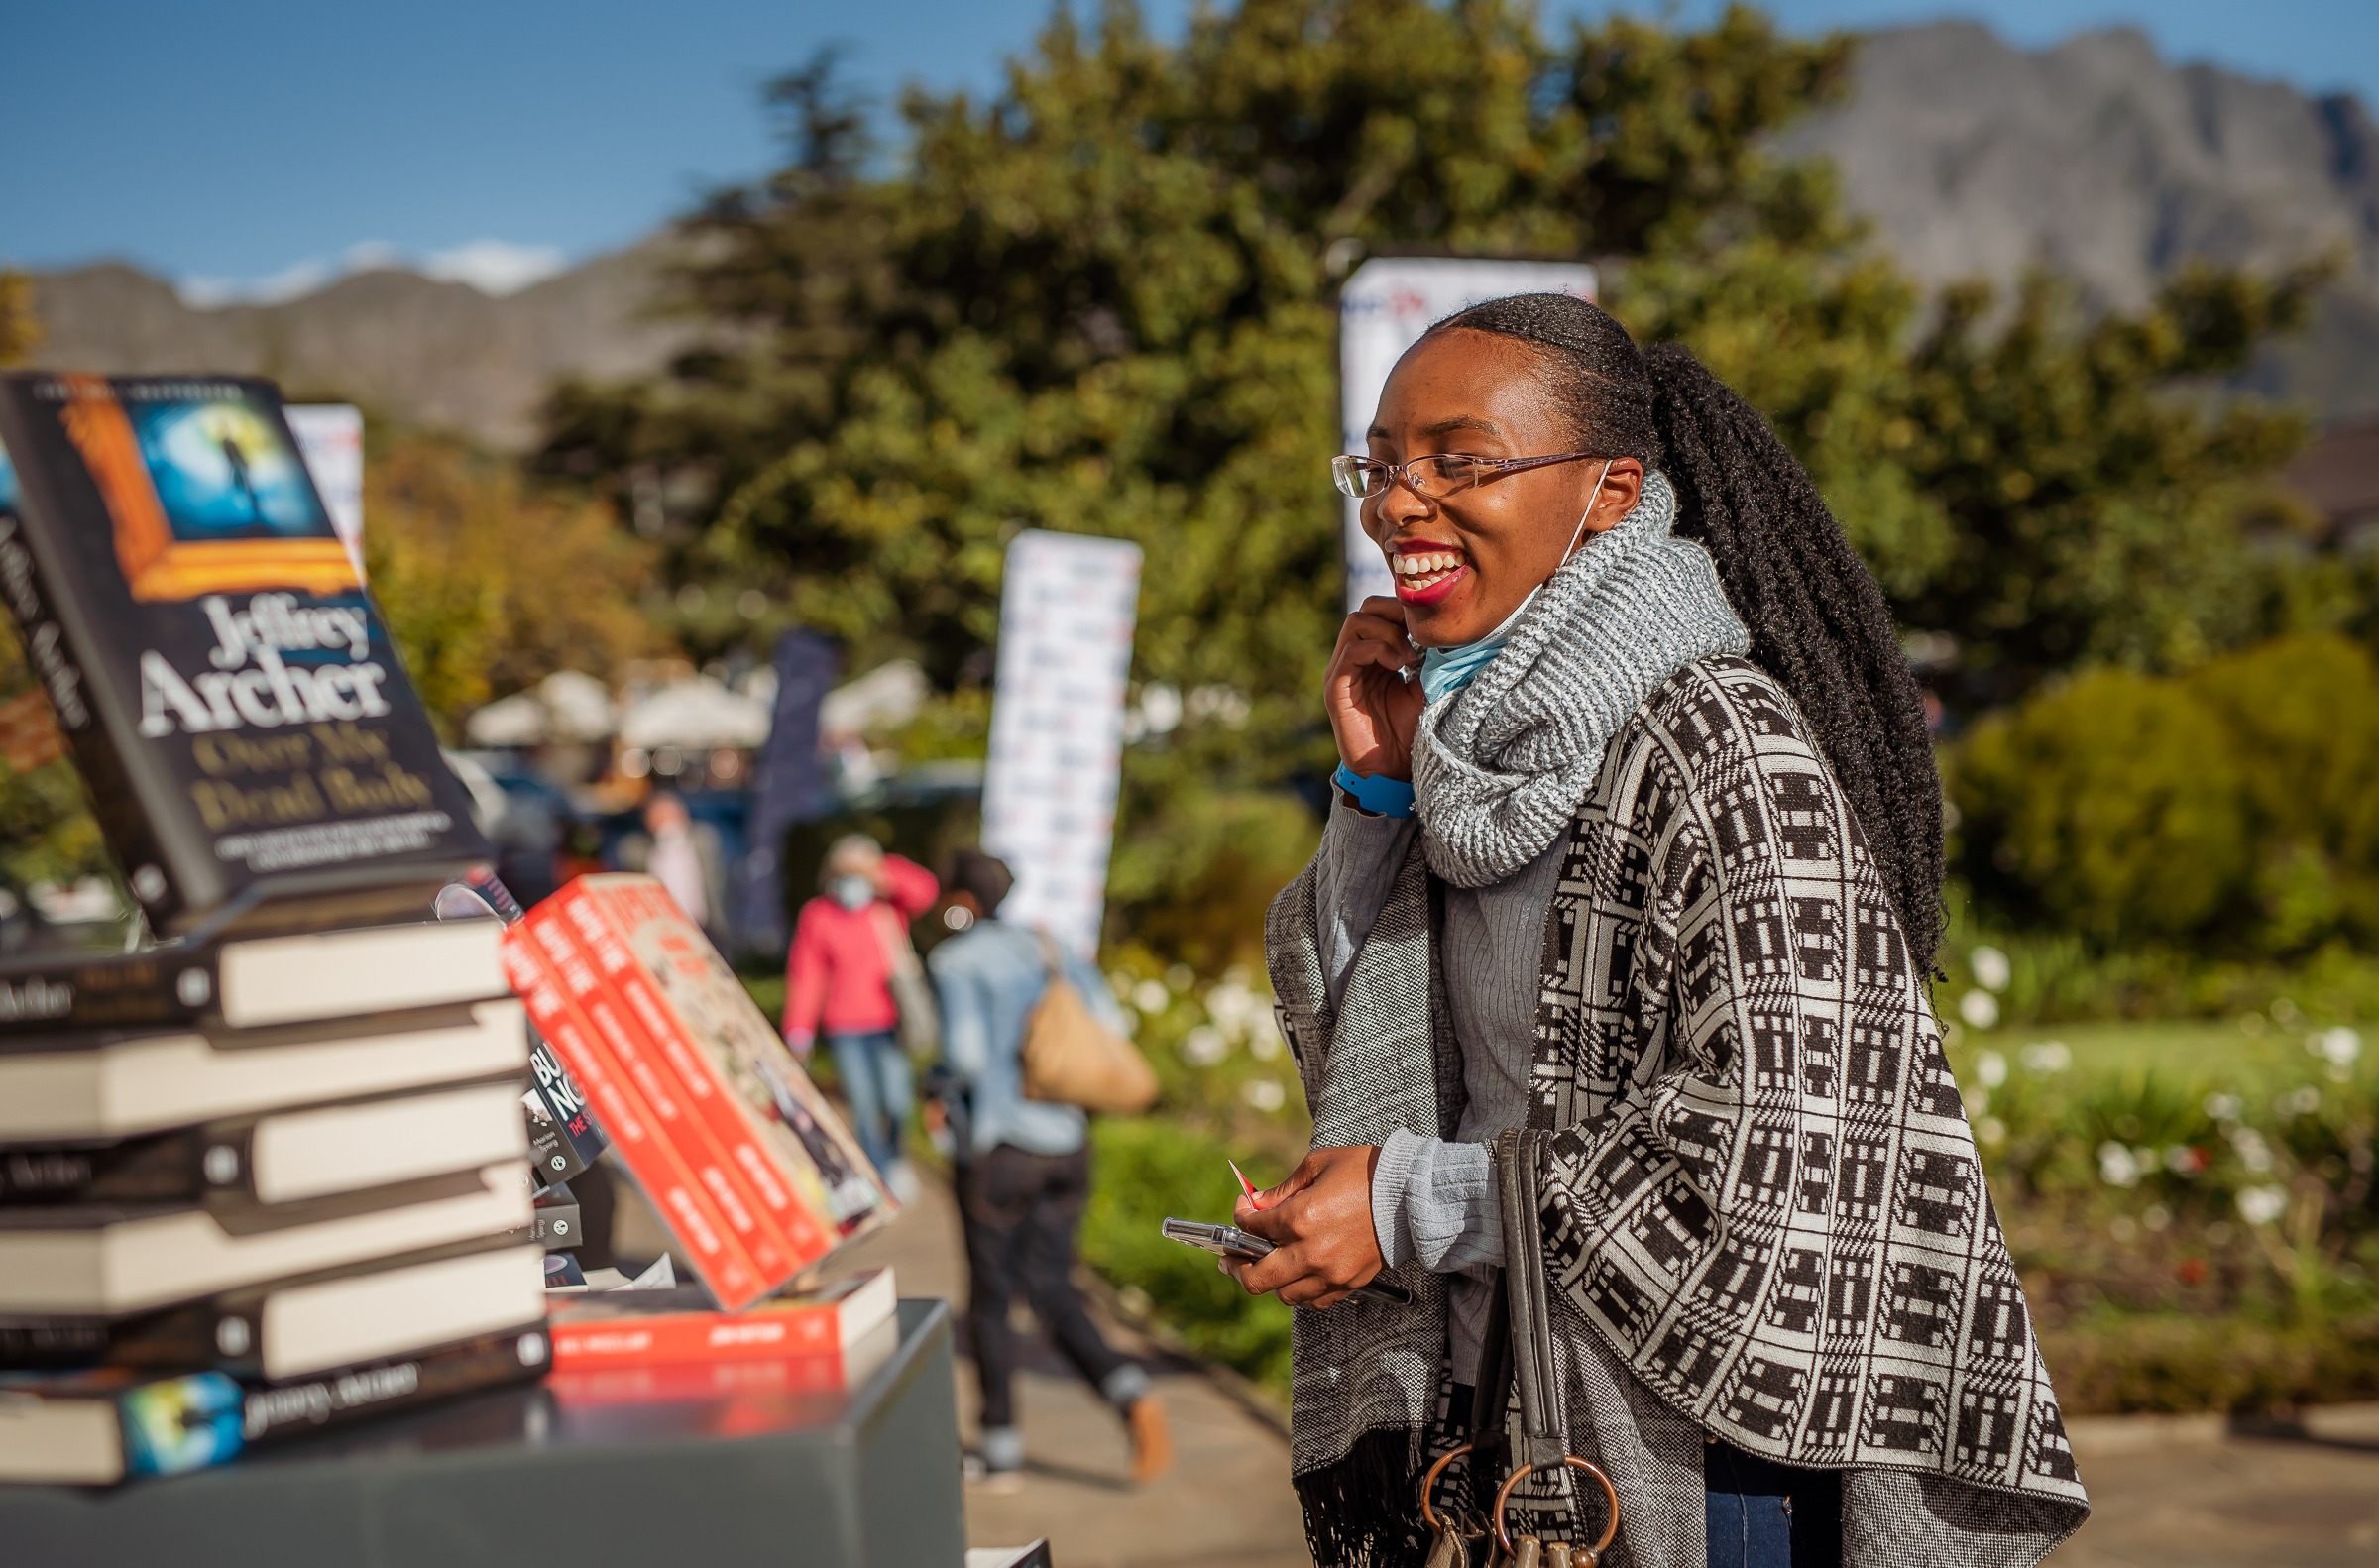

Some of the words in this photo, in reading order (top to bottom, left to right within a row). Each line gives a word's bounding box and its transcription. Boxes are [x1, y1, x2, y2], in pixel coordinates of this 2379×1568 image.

[202, 592, 369, 670] Jeffrey
[139, 642, 393, 738] Archer
[193, 732, 311, 778] Over
[191, 774, 327, 834] Dead
[318, 760, 435, 815] Body
[568, 1115, 588, 1137] THE
